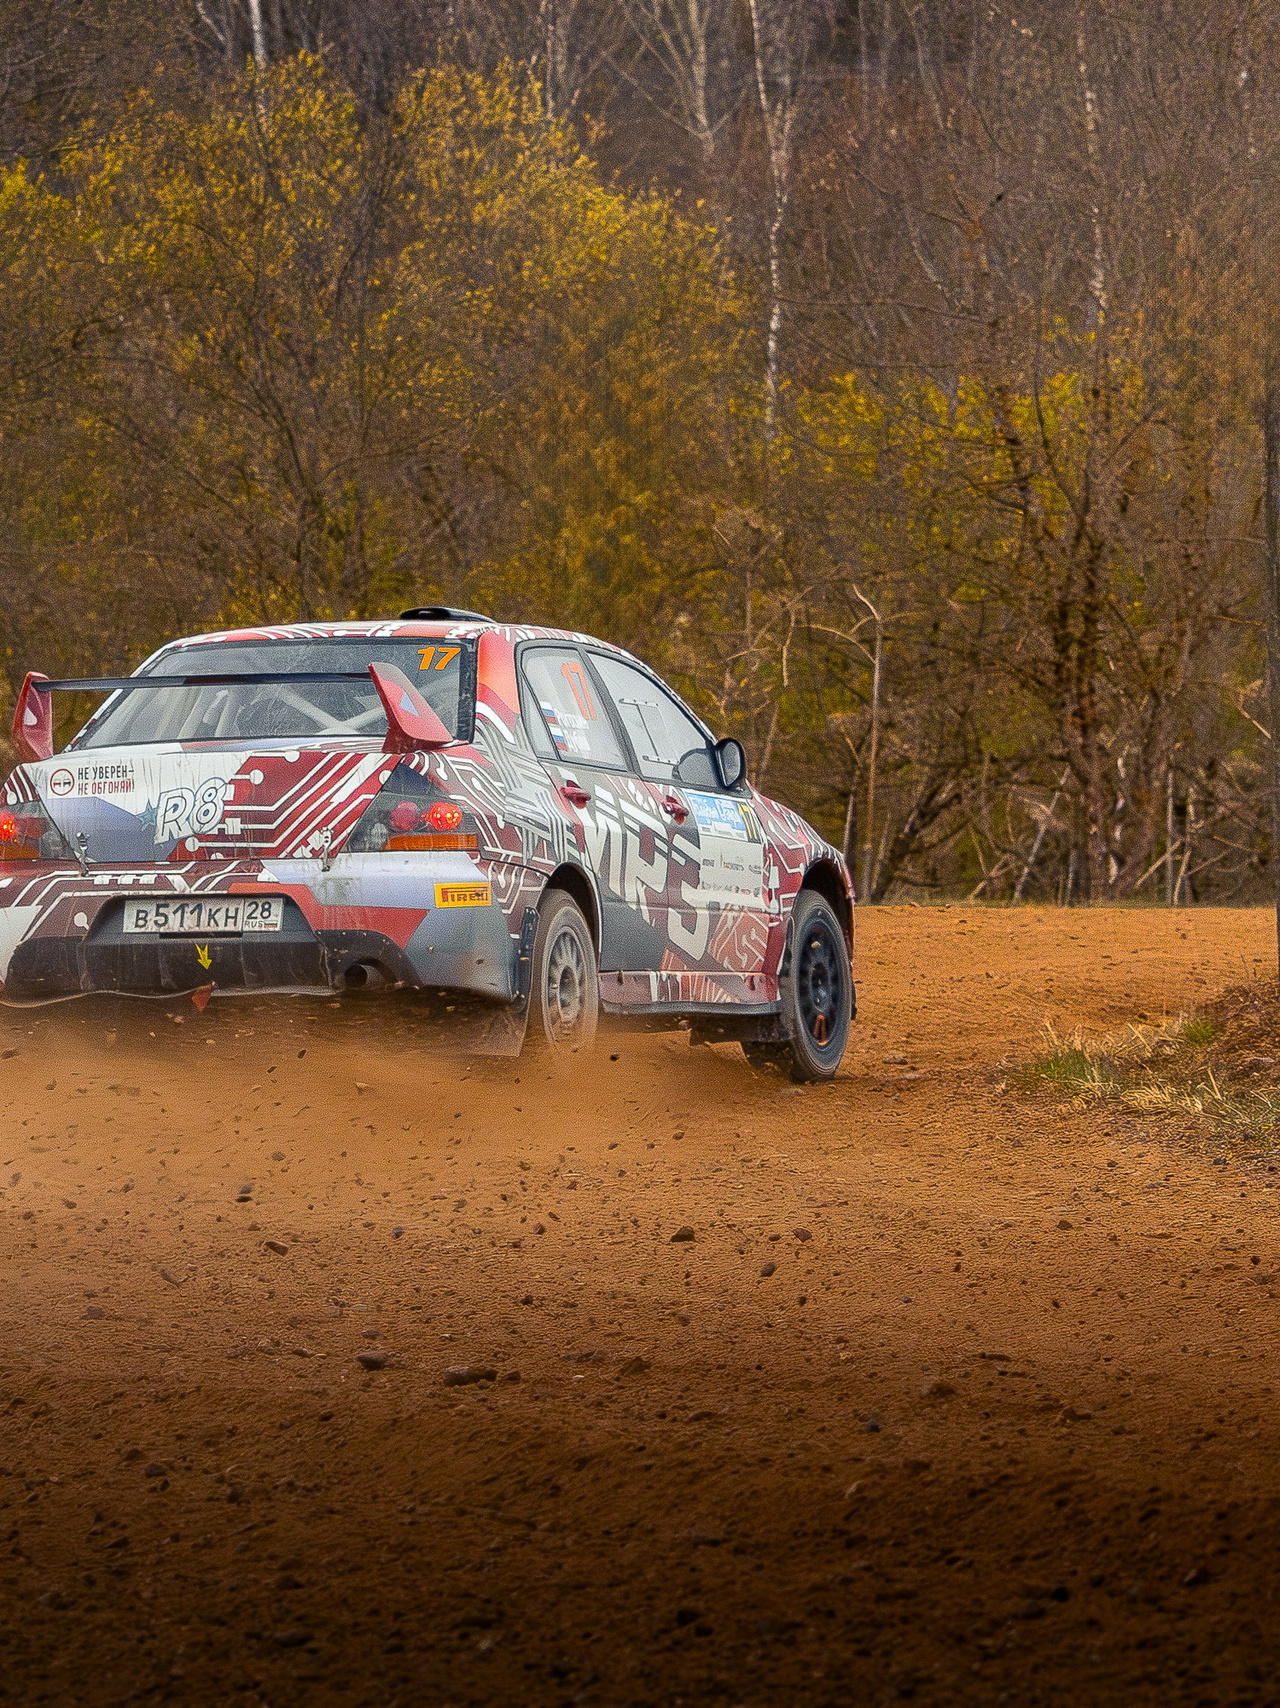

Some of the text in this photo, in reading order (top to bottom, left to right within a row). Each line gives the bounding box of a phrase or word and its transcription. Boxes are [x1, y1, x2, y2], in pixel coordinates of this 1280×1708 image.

[417, 646, 461, 670] 17
[560, 661, 597, 721] 17
[77, 767, 90, 781] НЕ
[77, 782, 89, 796] НЕ
[737, 801, 758, 841] 17
[246, 901, 272, 920] 28
[244, 920, 264, 929] RUS
